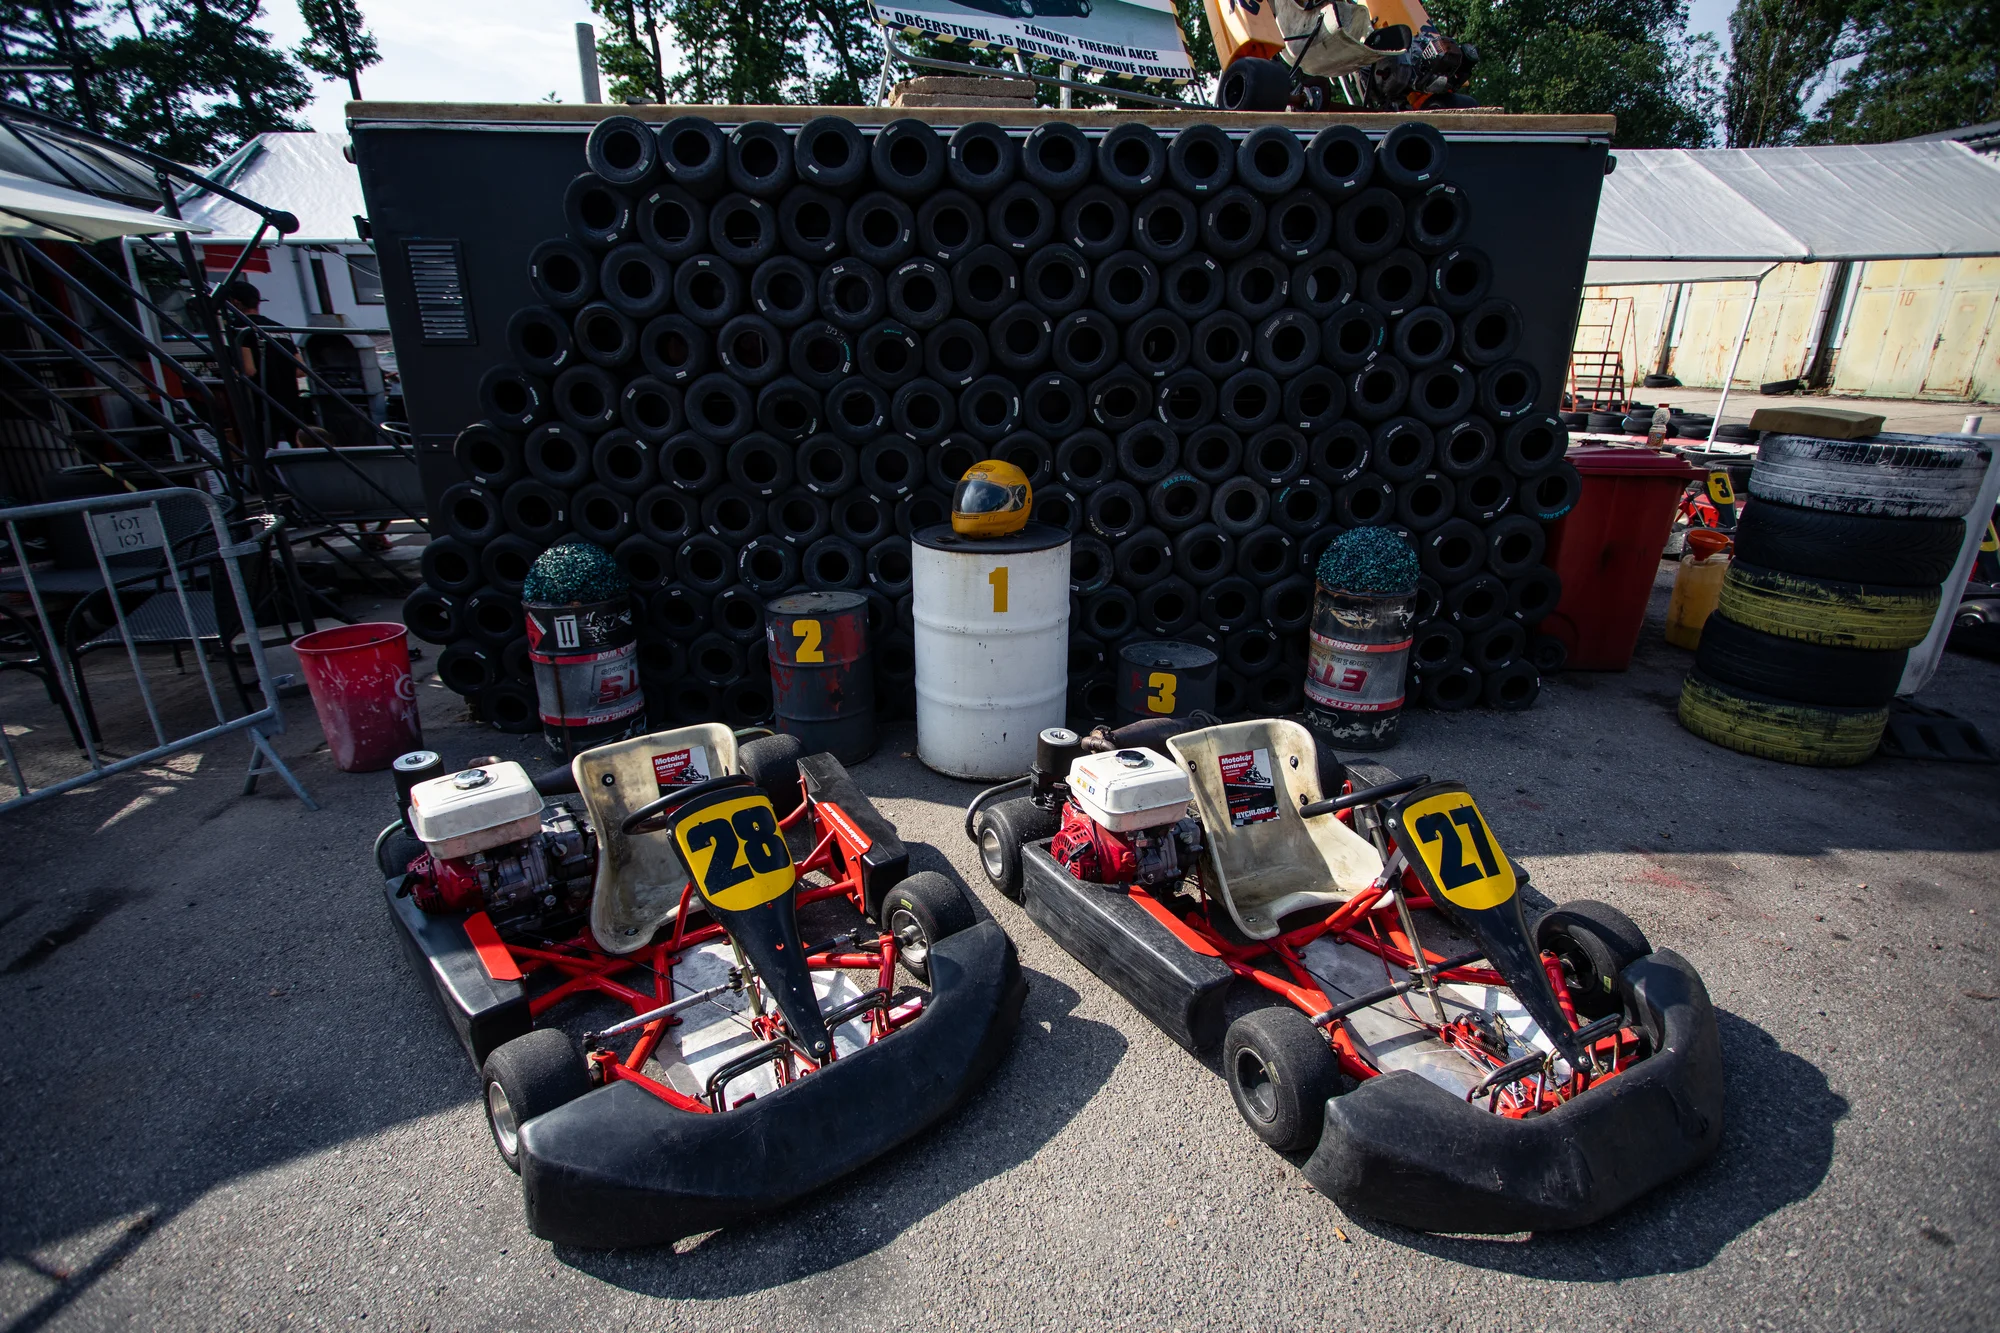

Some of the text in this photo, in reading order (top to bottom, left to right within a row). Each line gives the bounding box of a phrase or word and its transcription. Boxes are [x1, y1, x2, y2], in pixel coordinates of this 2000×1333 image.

[894, 11, 1191, 79] OBČERSTVENÍ 15 MOTOKÁR DÁRKOVÉ POUKAZY
[1022, 23, 1160, 61] ZÁVODY FIREMNÍ AKCE
[1899, 291, 1917, 307] 10
[1161, 474, 1192, 490] MAXXIS
[1714, 477, 1731, 498] 3
[1542, 504, 1571, 520] MAXXIS
[988, 566, 1009, 612] 1
[792, 619, 825, 663] 2
[1308, 654, 1368, 694] ETS
[1147, 671, 1177, 714] 3
[654, 753, 689, 766] Motokár
[656, 761, 685, 771] centrum
[1221, 754, 1252, 765] Motokár
[1223, 762, 1249, 770] centrum
[686, 805, 790, 897] 28
[1415, 805, 1501, 891] 27
